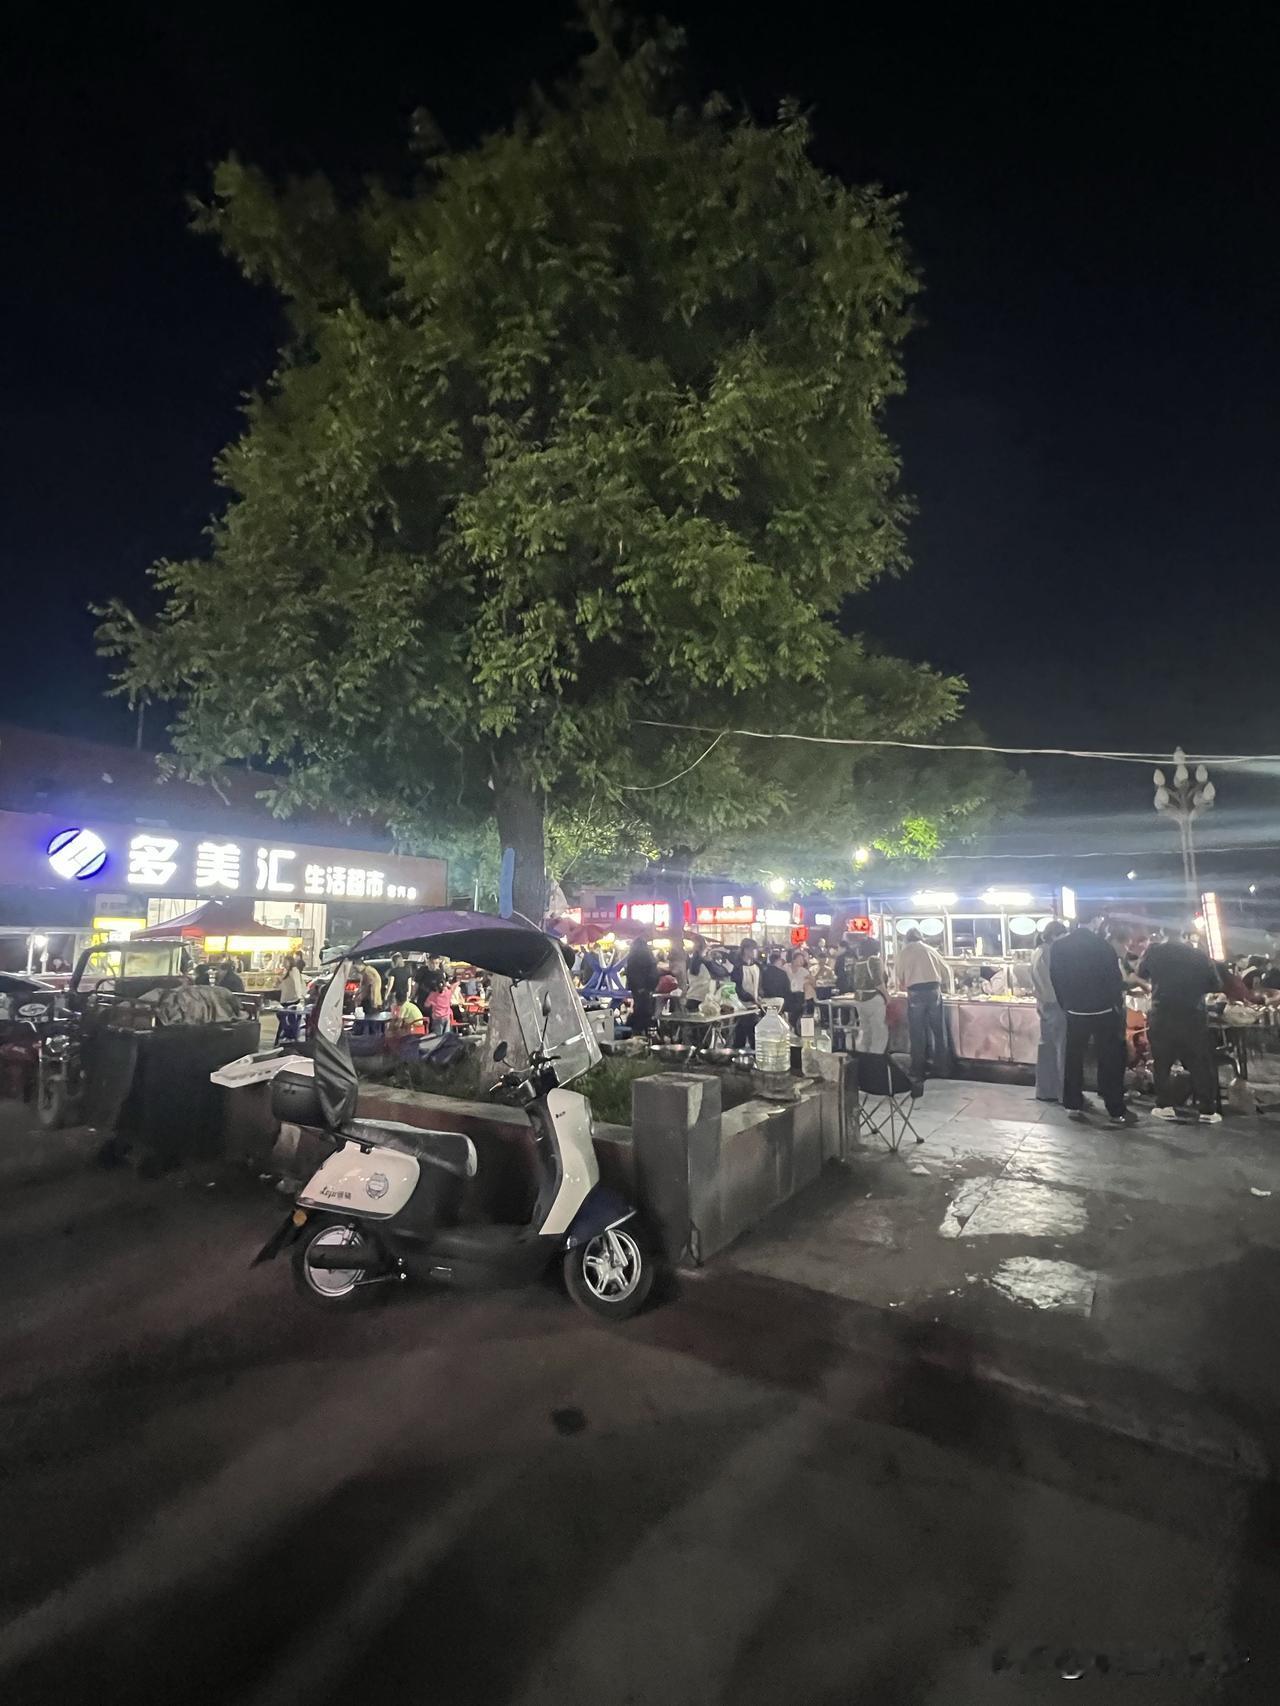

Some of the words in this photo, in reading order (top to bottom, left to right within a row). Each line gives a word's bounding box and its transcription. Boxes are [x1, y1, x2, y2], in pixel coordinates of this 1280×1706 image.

[127, 834, 296, 892] 多美汇
[304, 864, 384, 896] 生活超市
